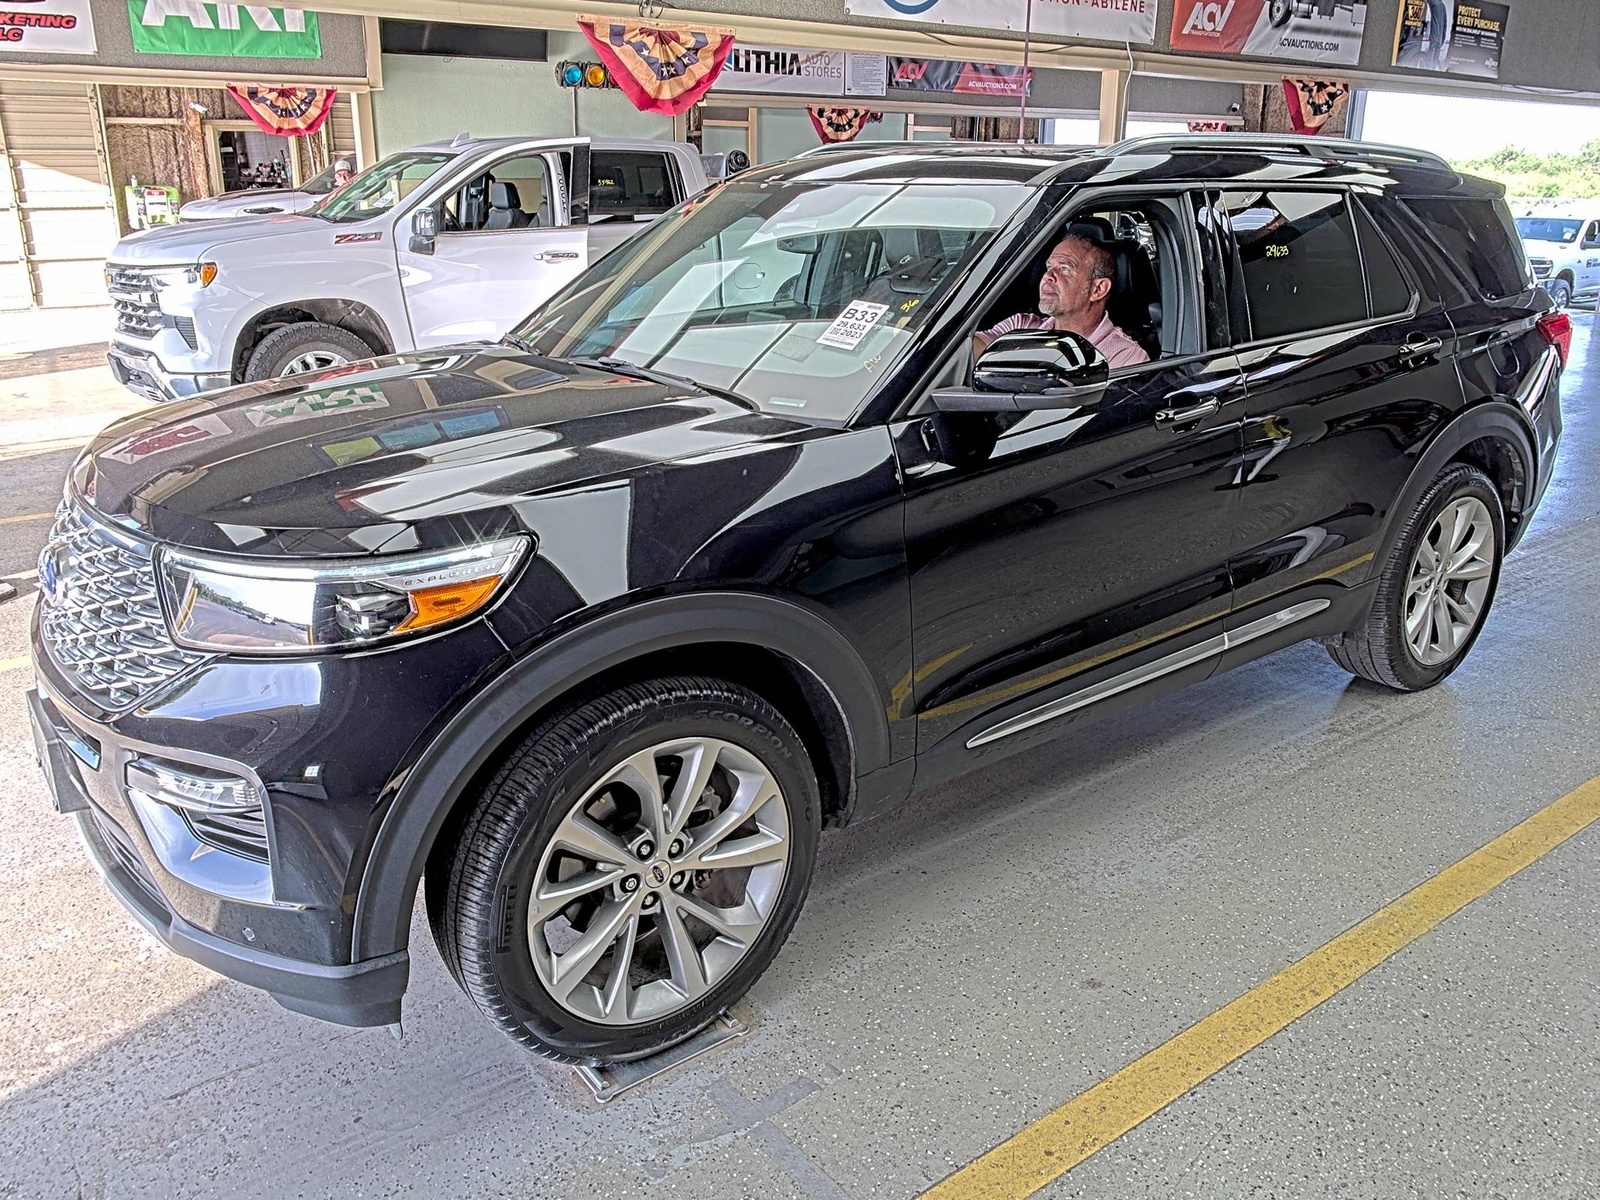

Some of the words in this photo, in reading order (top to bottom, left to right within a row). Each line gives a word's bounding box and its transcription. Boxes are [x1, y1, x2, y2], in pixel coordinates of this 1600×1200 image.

[1182, 0, 1235, 34] ACV
[1457, 5, 1481, 18] PROTECT
[1456, 15, 1474, 27] EVERY
[1279, 37, 1340, 52] ACVAUCTIONS.COM
[733, 48, 802, 76] LITHIA
[805, 54, 831, 66] AUTO
[804, 65, 842, 79] STORES
[893, 60, 929, 81] ACV
[968, 80, 1017, 90] ACVAUCTIONS.COM
[841, 307, 879, 324] B33
[840, 329, 864, 339] 2023
[404, 563, 496, 586] EXPLORER
[695, 708, 793, 760] SCORPION
[496, 884, 518, 955] PIRELLI
